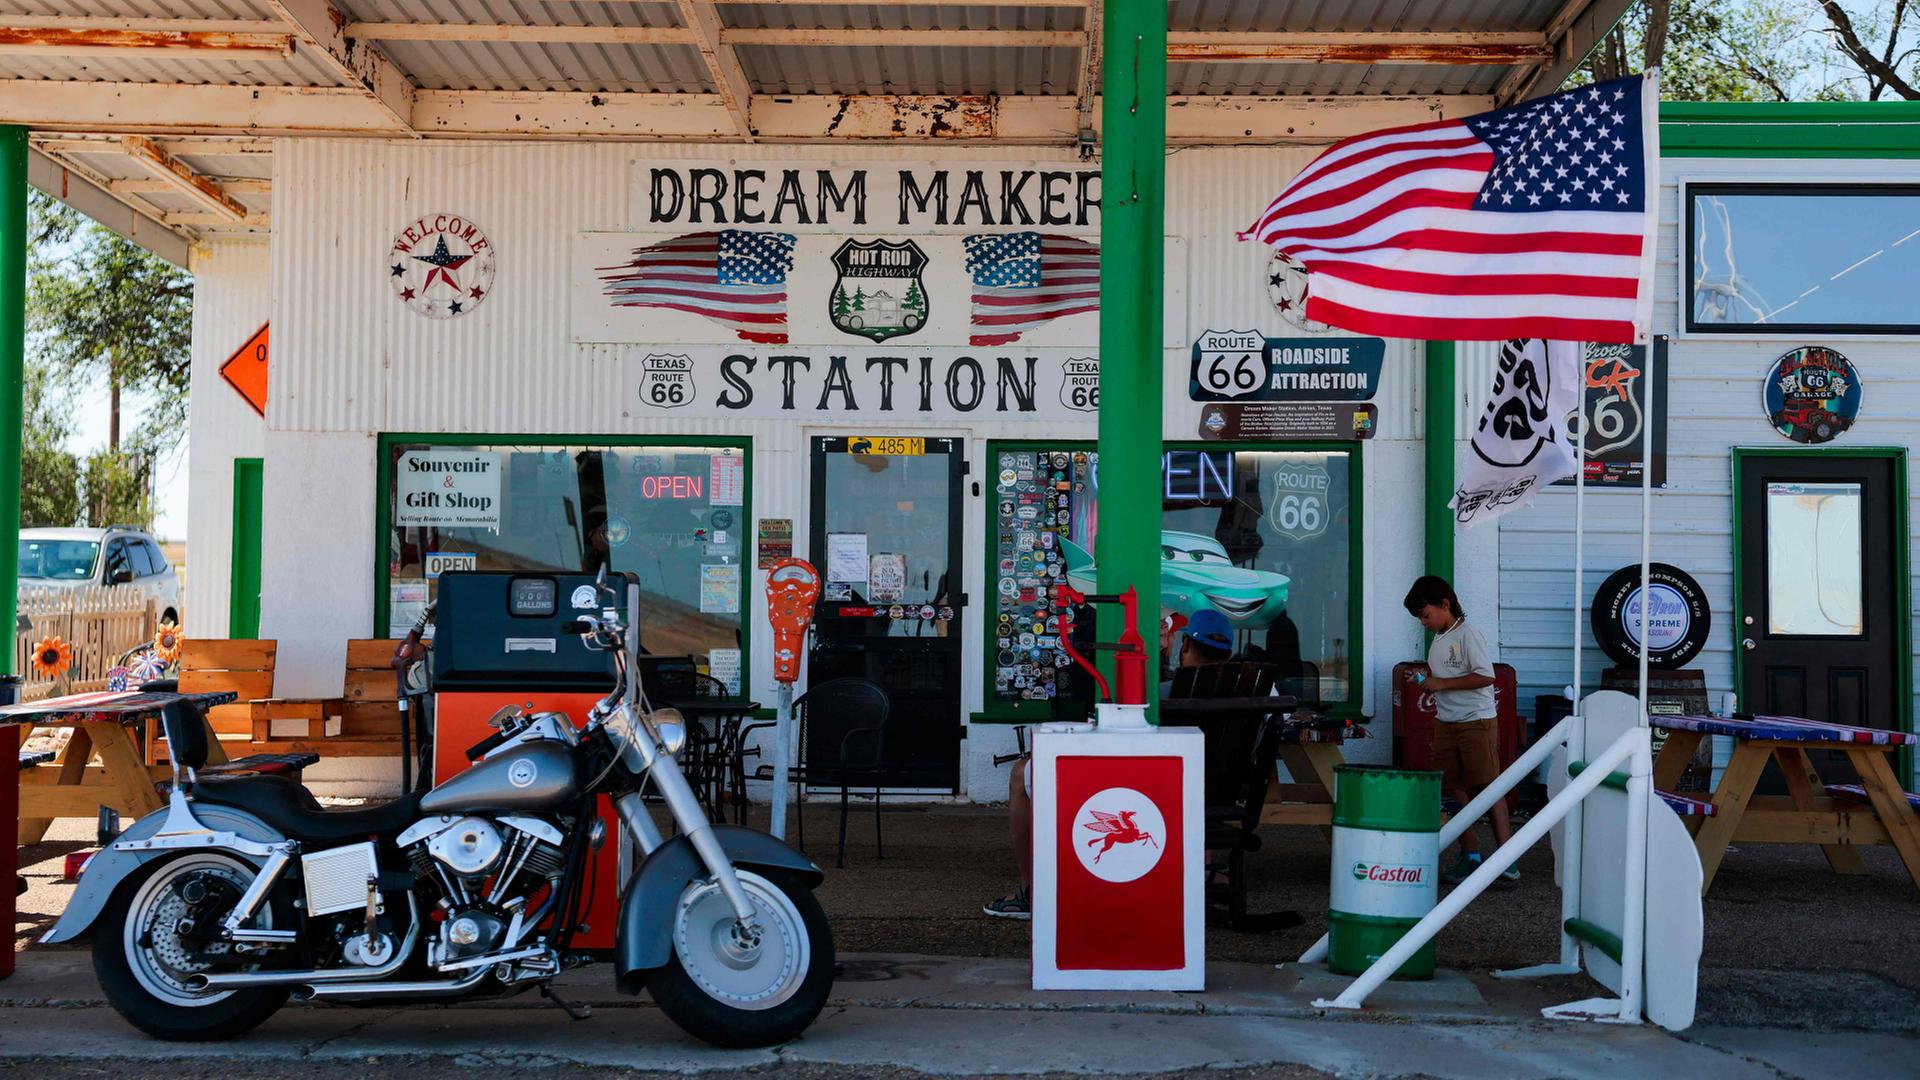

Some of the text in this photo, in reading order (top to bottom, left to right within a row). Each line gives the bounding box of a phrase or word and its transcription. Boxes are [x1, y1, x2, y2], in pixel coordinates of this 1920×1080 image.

[649, 168, 1101, 225] DREAM MAKER
[395, 215, 489, 255] WELCOME
[849, 249, 912, 266] HOT ROD
[845, 267, 915, 278] HIGHWAY
[1208, 337, 1256, 348] ROUTE
[649, 359, 686, 370] TEXAS
[1271, 348, 1350, 365] ROADSIDE
[1070, 362, 1099, 372] TEXA
[1208, 353, 1256, 390] 66
[651, 373, 684, 383] ROUTE
[716, 354, 1037, 412] STATION
[1071, 376, 1099, 386] ROUT
[1271, 372, 1368, 390] ATTRACTION
[1806, 375, 1825, 388] 66
[650, 383, 684, 405] 66
[1071, 387, 1100, 408] 66
[878, 439, 904, 454] 485
[408, 457, 491, 473] Souvenir
[443, 475, 455, 489] &
[642, 476, 702, 498] OPEN
[1279, 472, 1327, 489] ROUTE
[405, 492, 492, 511] Gift Shop
[399, 515, 423, 523] Selling
[423, 515, 442, 523] Route
[456, 515, 498, 523] Memorabilia
[1280, 495, 1320, 531] 66
[431, 558, 472, 574] OPEN
[1640, 573, 1695, 597] HOMPSON
[516, 601, 552, 609] GALLONS
[1611, 582, 1632, 619] MICKEY
[1635, 619, 1681, 628] SPREME
[1647, 629, 1674, 637] ASOLINE
[1621, 642, 1662, 663] PRFILE
[1671, 641, 1694, 660] INDY
[1369, 865, 1422, 883] Castrol
